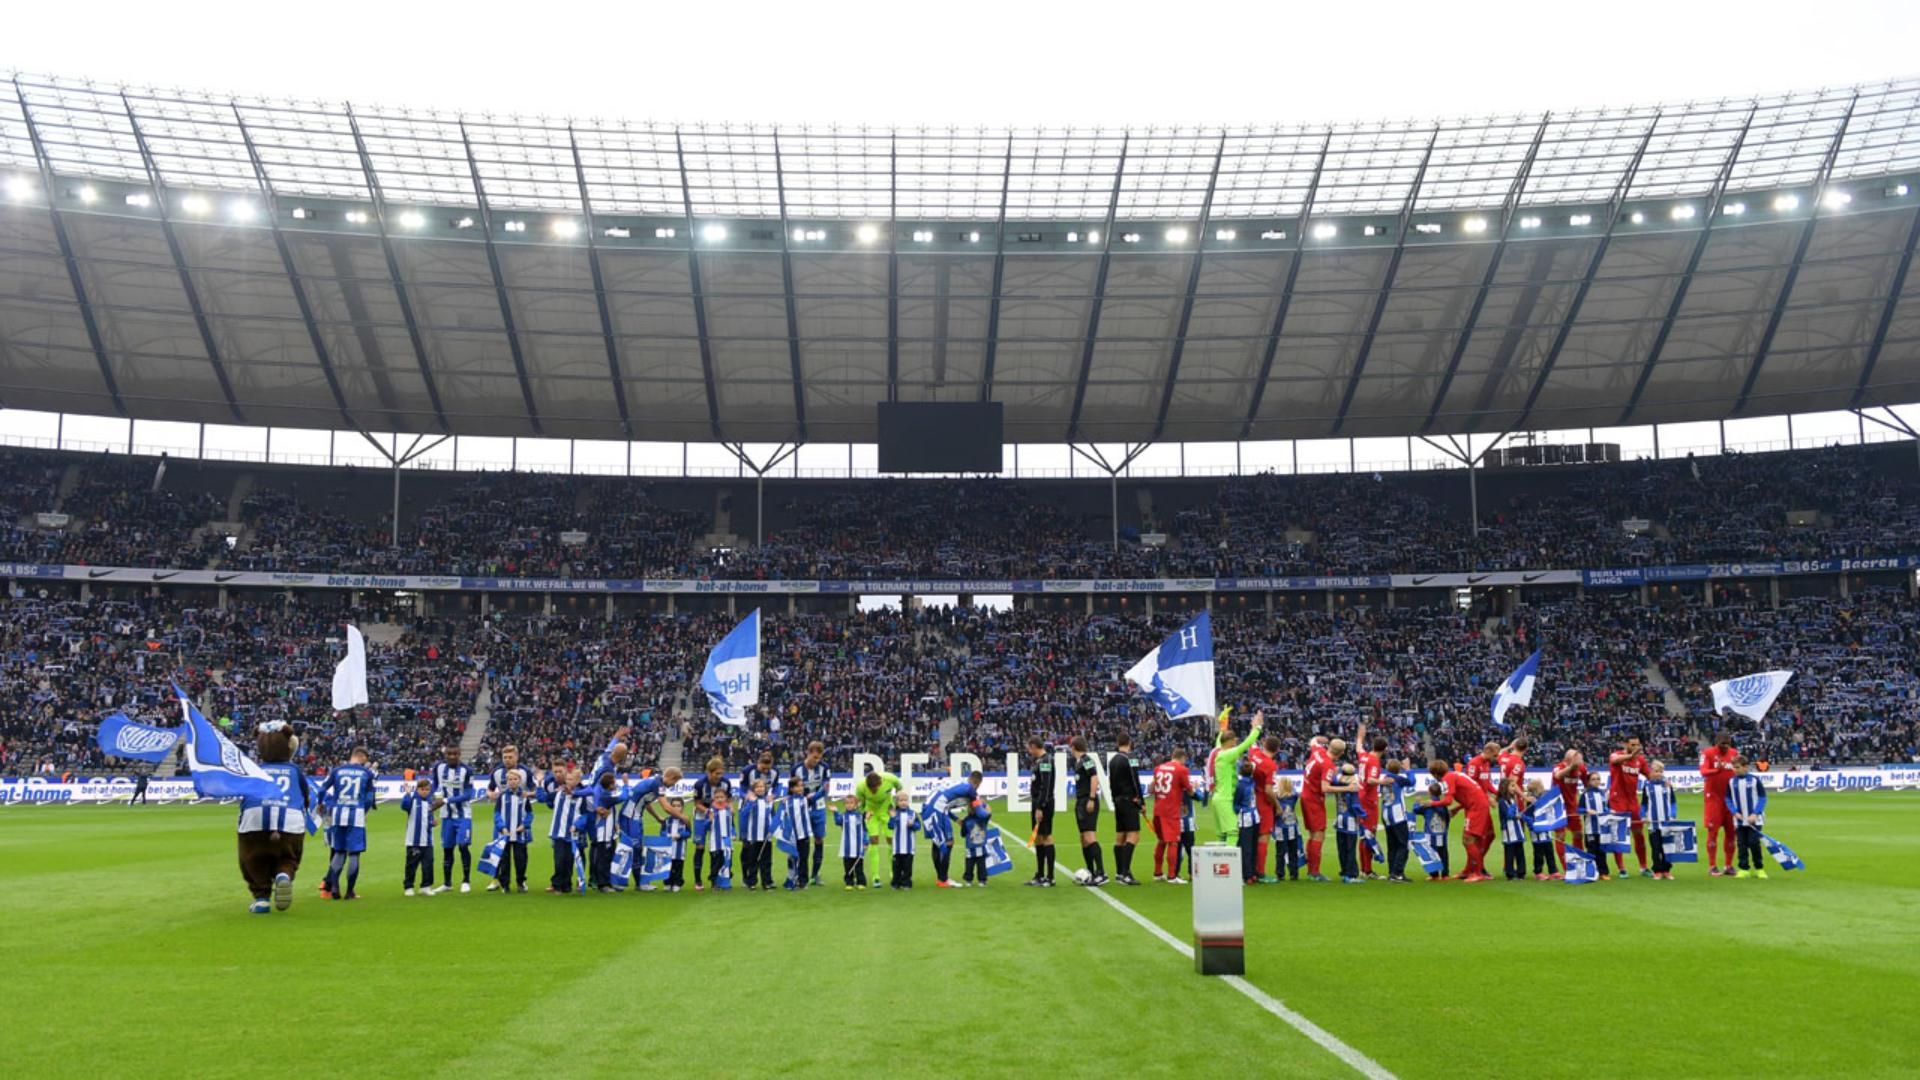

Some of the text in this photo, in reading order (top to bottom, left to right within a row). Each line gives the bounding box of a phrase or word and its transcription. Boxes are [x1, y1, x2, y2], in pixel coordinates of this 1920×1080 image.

[16, 565, 38, 575] BSC
[1589, 568, 1640, 578] BERLINER
[327, 575, 407, 587] bet-at-home
[696, 580, 769, 592] bet-at-home
[1094, 580, 1164, 591] bet-at-home
[1237, 578, 1270, 588] HERTHA
[1315, 577, 1350, 587] HERTHA
[1590, 576, 1623, 585] JUNGS
[1180, 625, 1198, 650] H
[1155, 772, 1173, 793] 33
[1783, 773, 1882, 788] bet-at-home
[340, 776, 360, 799] 21
